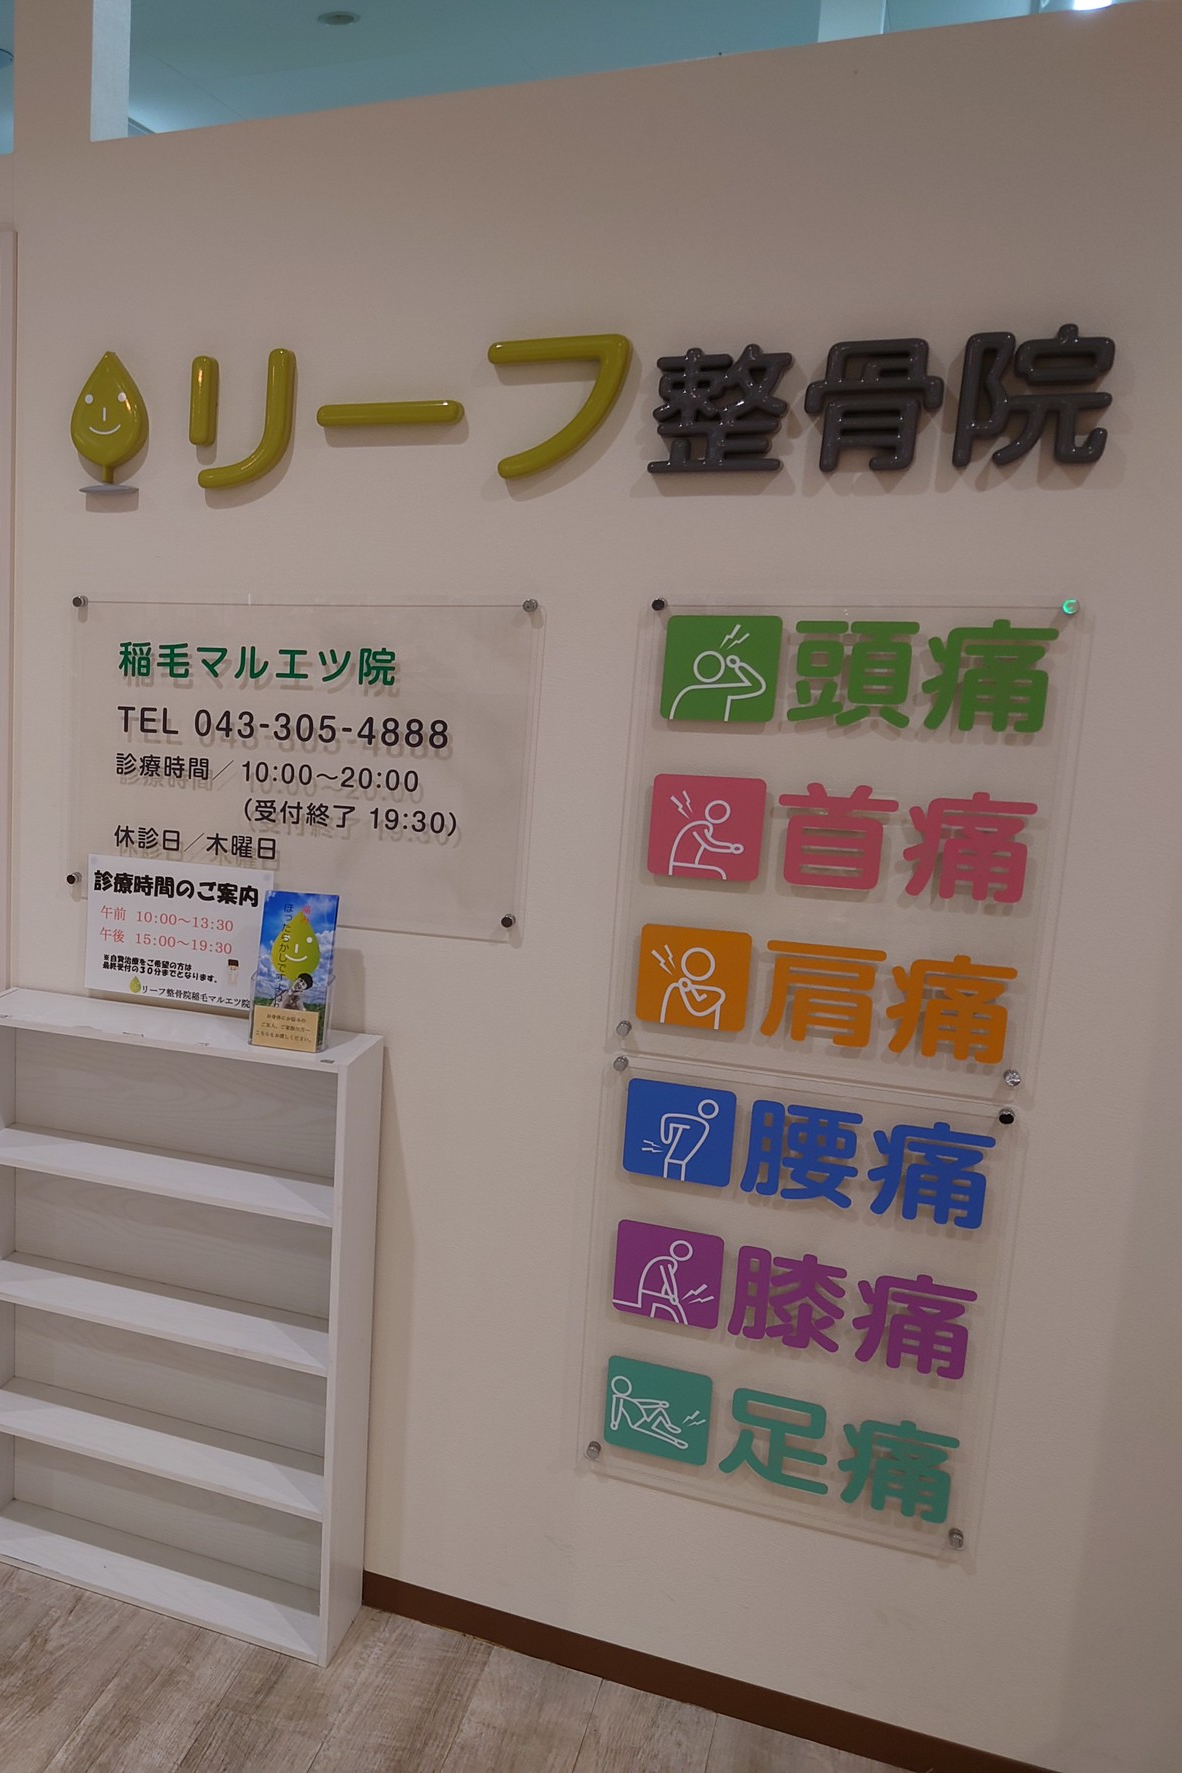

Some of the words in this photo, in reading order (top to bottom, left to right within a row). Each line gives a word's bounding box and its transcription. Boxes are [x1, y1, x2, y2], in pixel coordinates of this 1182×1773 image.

[190, 324, 1116, 490] リーフ整骨院
[118, 640, 397, 686] 稲毛マルエツ院
[786, 618, 1060, 734] 頭痛
[118, 706, 179, 735] TEL
[194, 708, 450, 749] 043-305-4888
[243, 798, 356, 829] (受付終了
[369, 807, 458, 837] 19:30)
[778, 782, 1039, 904] 首痛
[93, 869, 260, 908] 診療時間のご案内
[100, 905, 127, 922] 午前
[135, 910, 234, 932] 10:00～13:30
[99, 927, 125, 944] 午後
[134, 932, 233, 955] 15:00～19:30
[141, 985, 251, 1009] リーフ整骨院稲毛マルエツ院
[760, 940, 1018, 1064] 肩痛
[740, 1099, 997, 1230] 腰痛
[727, 1244, 978, 1381] 膝痛
[718, 1387, 961, 1525] 足痛
